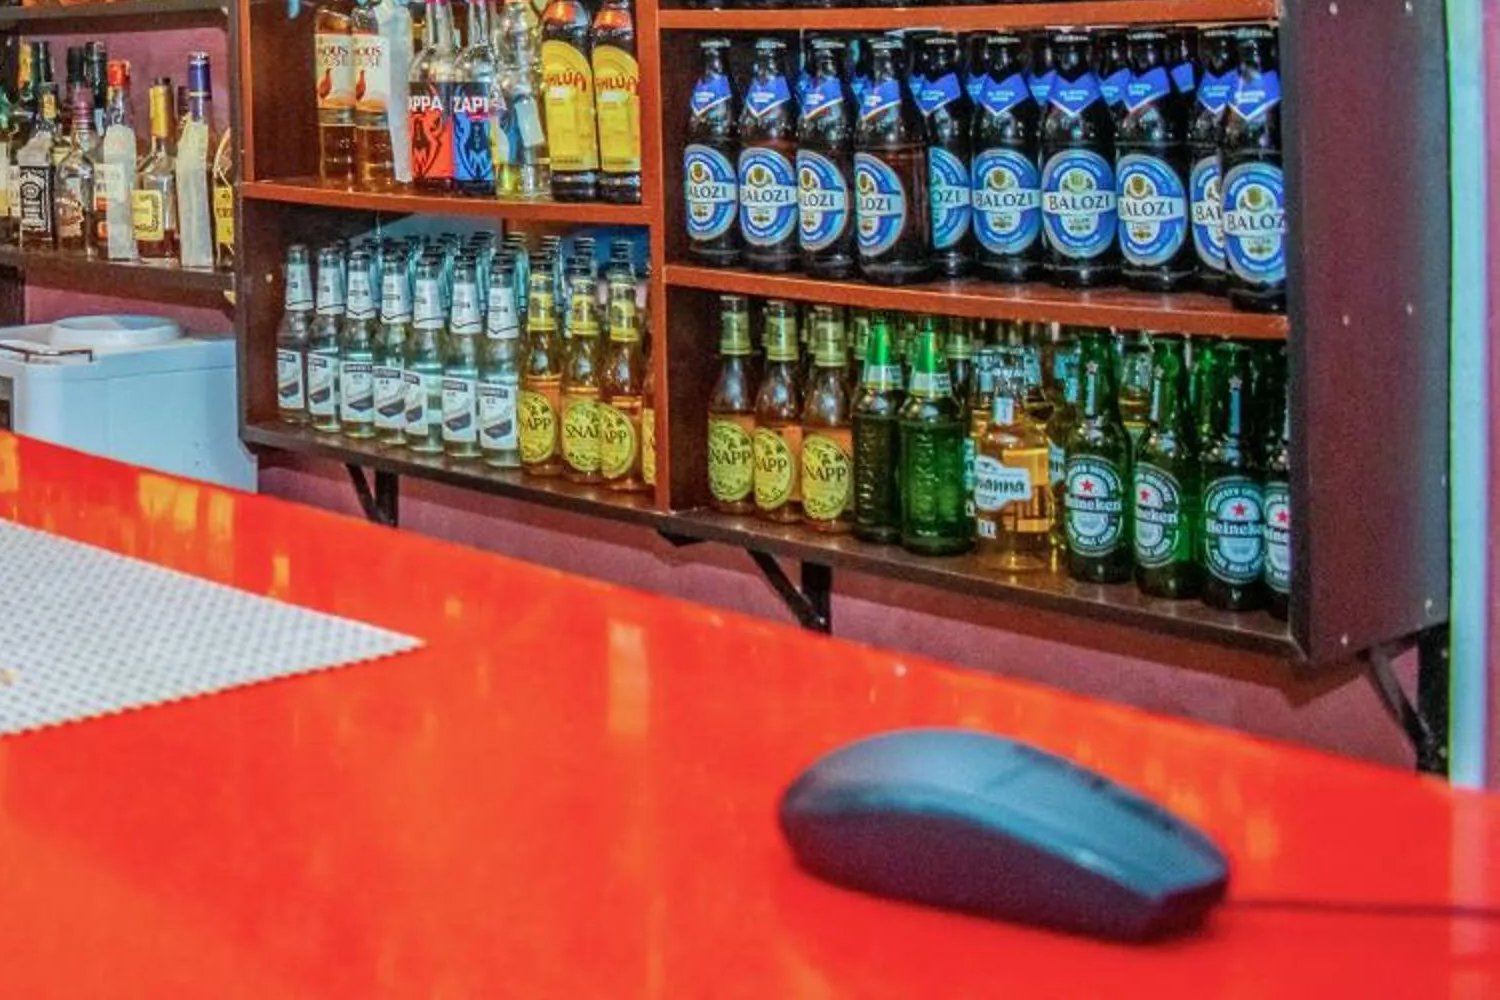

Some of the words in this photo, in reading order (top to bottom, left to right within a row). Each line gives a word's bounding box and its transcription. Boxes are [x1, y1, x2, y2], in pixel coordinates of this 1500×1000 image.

[689, 185, 727, 200] ALOZI
[802, 194, 835, 207] LOZI
[975, 190, 1033, 206] BALOZI
[1049, 195, 1109, 211] BALOZI
[1196, 205, 1222, 221] BAL
[1226, 213, 1286, 232] BALOZ
[710, 449, 752, 465] NAPP
[805, 465, 847, 482] NAPP
